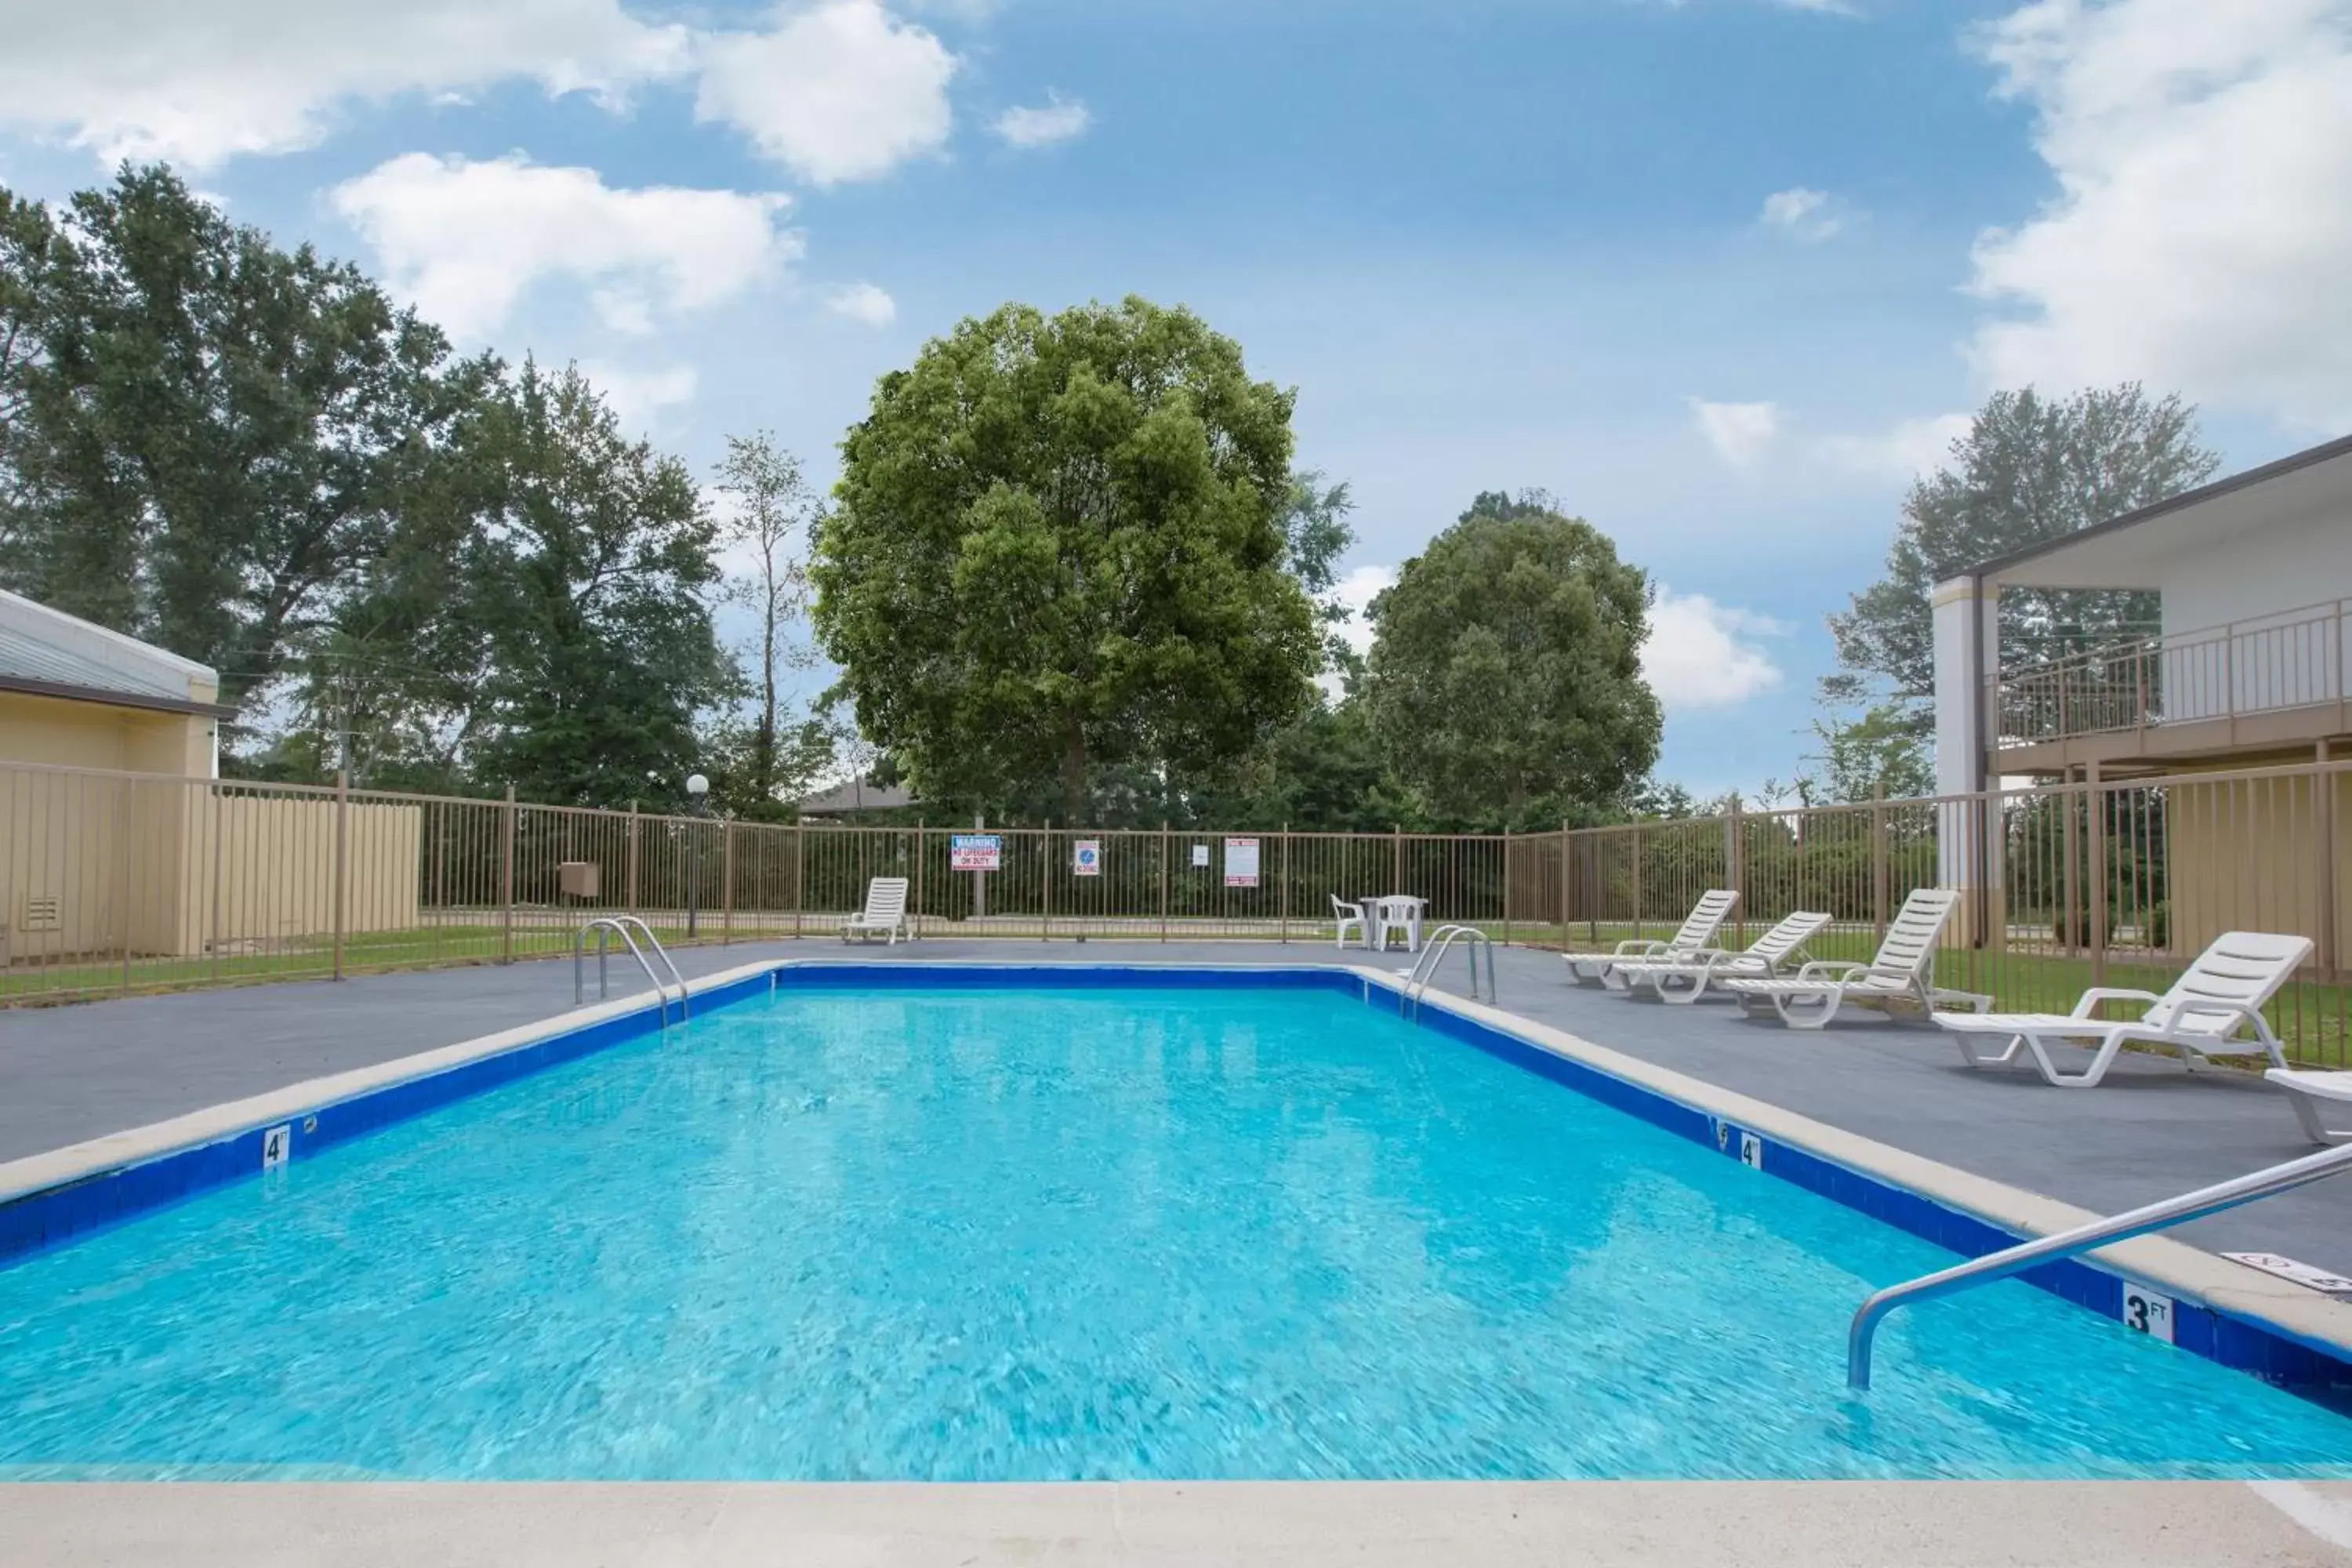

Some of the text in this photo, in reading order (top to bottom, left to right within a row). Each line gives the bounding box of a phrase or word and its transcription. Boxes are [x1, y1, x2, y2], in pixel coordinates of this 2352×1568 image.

[956, 837, 996, 848] WARNING
[267, 1134, 280, 1160] 4
[1743, 1140, 1752, 1165] 4
[2128, 1294, 2166, 1334] 3 FT
